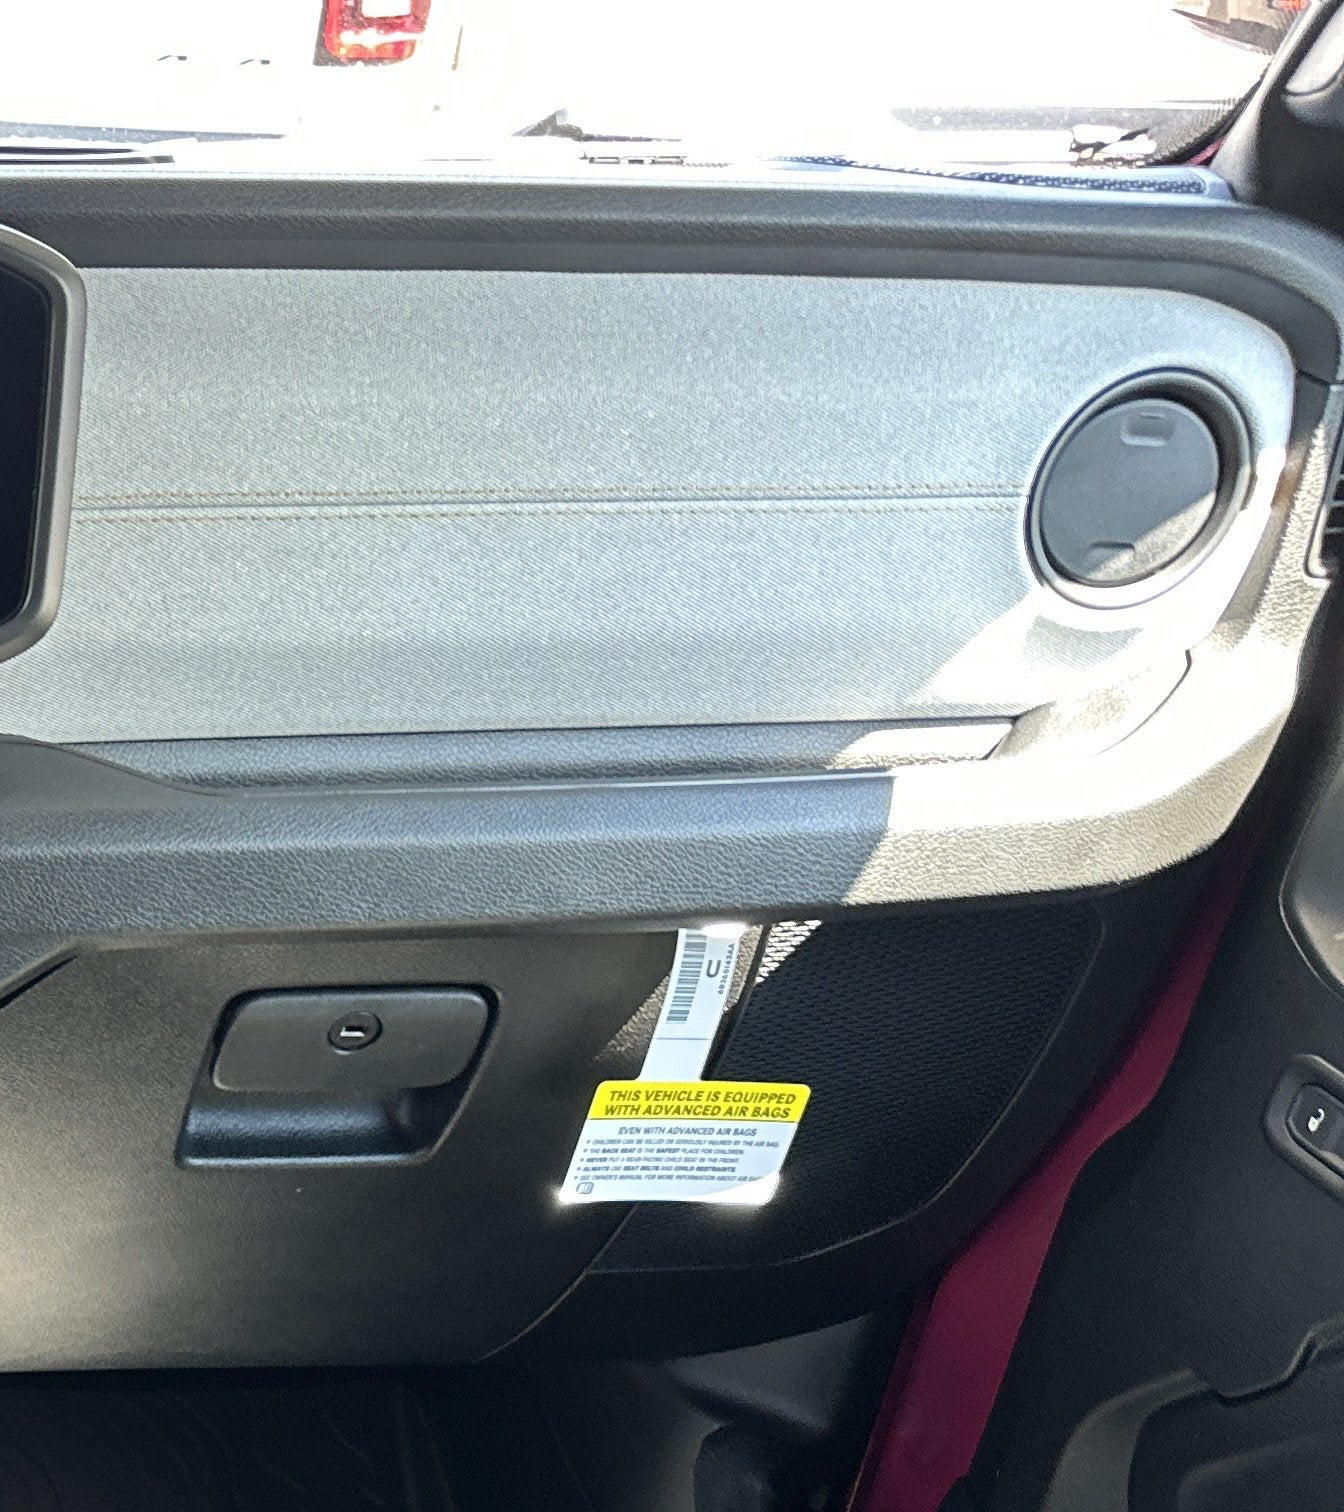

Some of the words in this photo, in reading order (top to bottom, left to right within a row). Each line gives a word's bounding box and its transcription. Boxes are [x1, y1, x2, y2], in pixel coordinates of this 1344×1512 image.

[706, 960, 722, 978] U
[610, 1090, 642, 1101] THIS
[644, 1090, 705, 1102] VEHICLE
[706, 1091, 721, 1103] IS
[722, 1091, 796, 1105] EQUIPPED
[604, 1105, 641, 1116] WITH
[642, 1105, 721, 1116] ADVANCED
[724, 1106, 748, 1117] AIR
[750, 1107, 791, 1118] BAGS
[618, 1126, 642, 1135] EVEN
[643, 1127, 666, 1135] WITH
[667, 1127, 715, 1136] ADVANCED
[716, 1128, 732, 1136] AIR
[733, 1128, 757, 1137] BAGS
